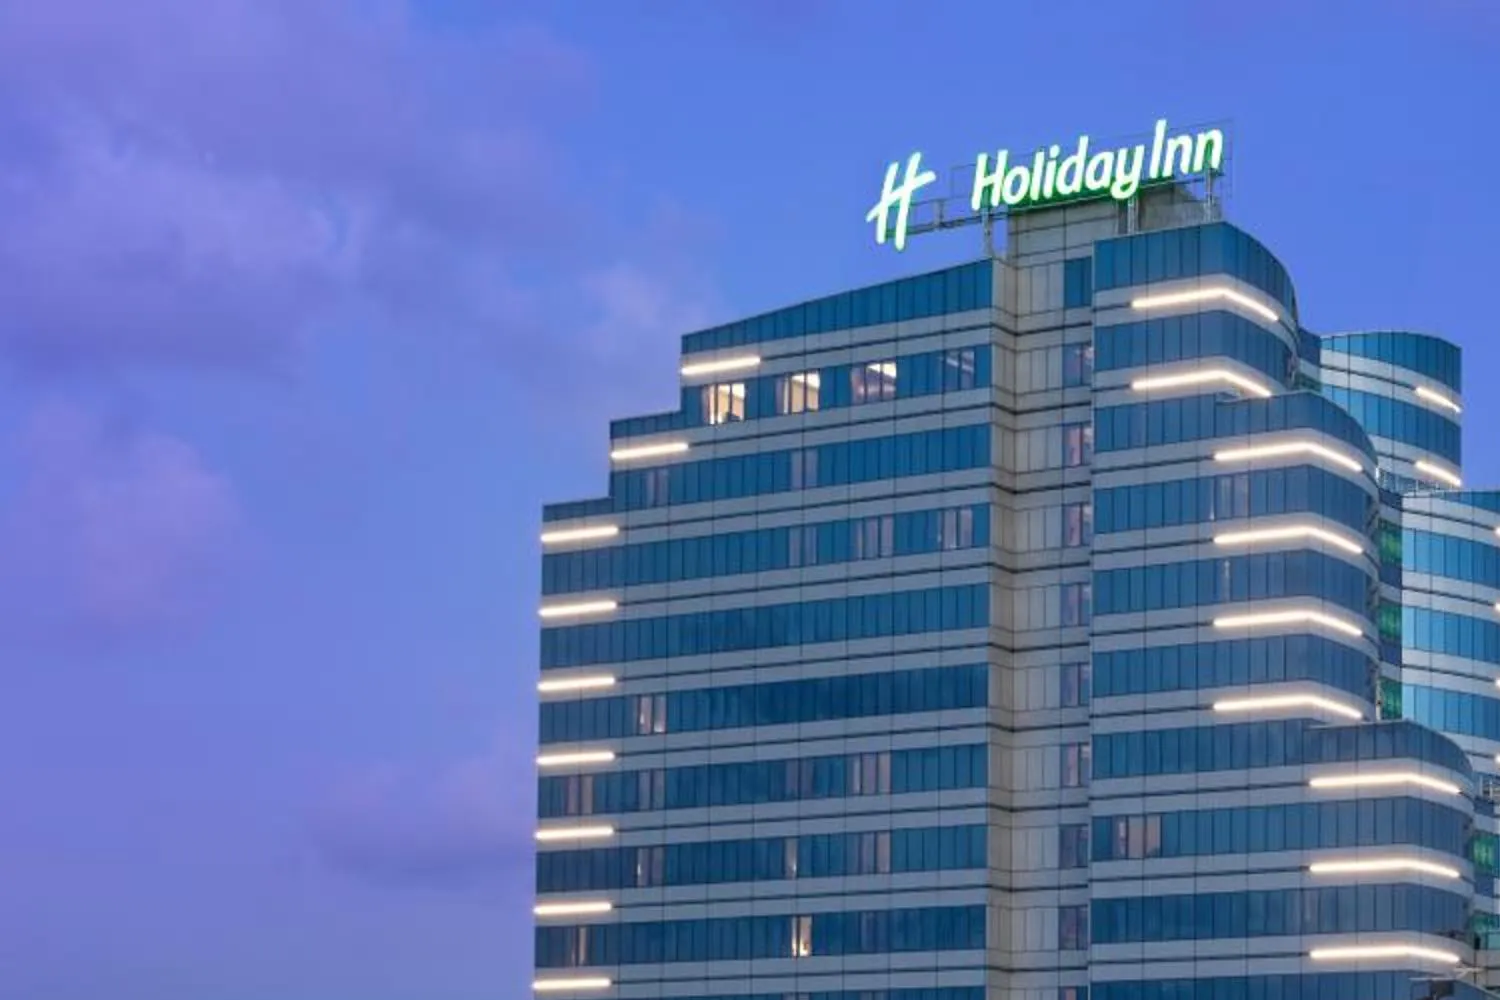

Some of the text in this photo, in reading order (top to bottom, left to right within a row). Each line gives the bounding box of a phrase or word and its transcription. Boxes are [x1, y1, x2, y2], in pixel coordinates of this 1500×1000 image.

[866, 151, 936, 251] H
[971, 119, 1223, 211] Holiday Inn
